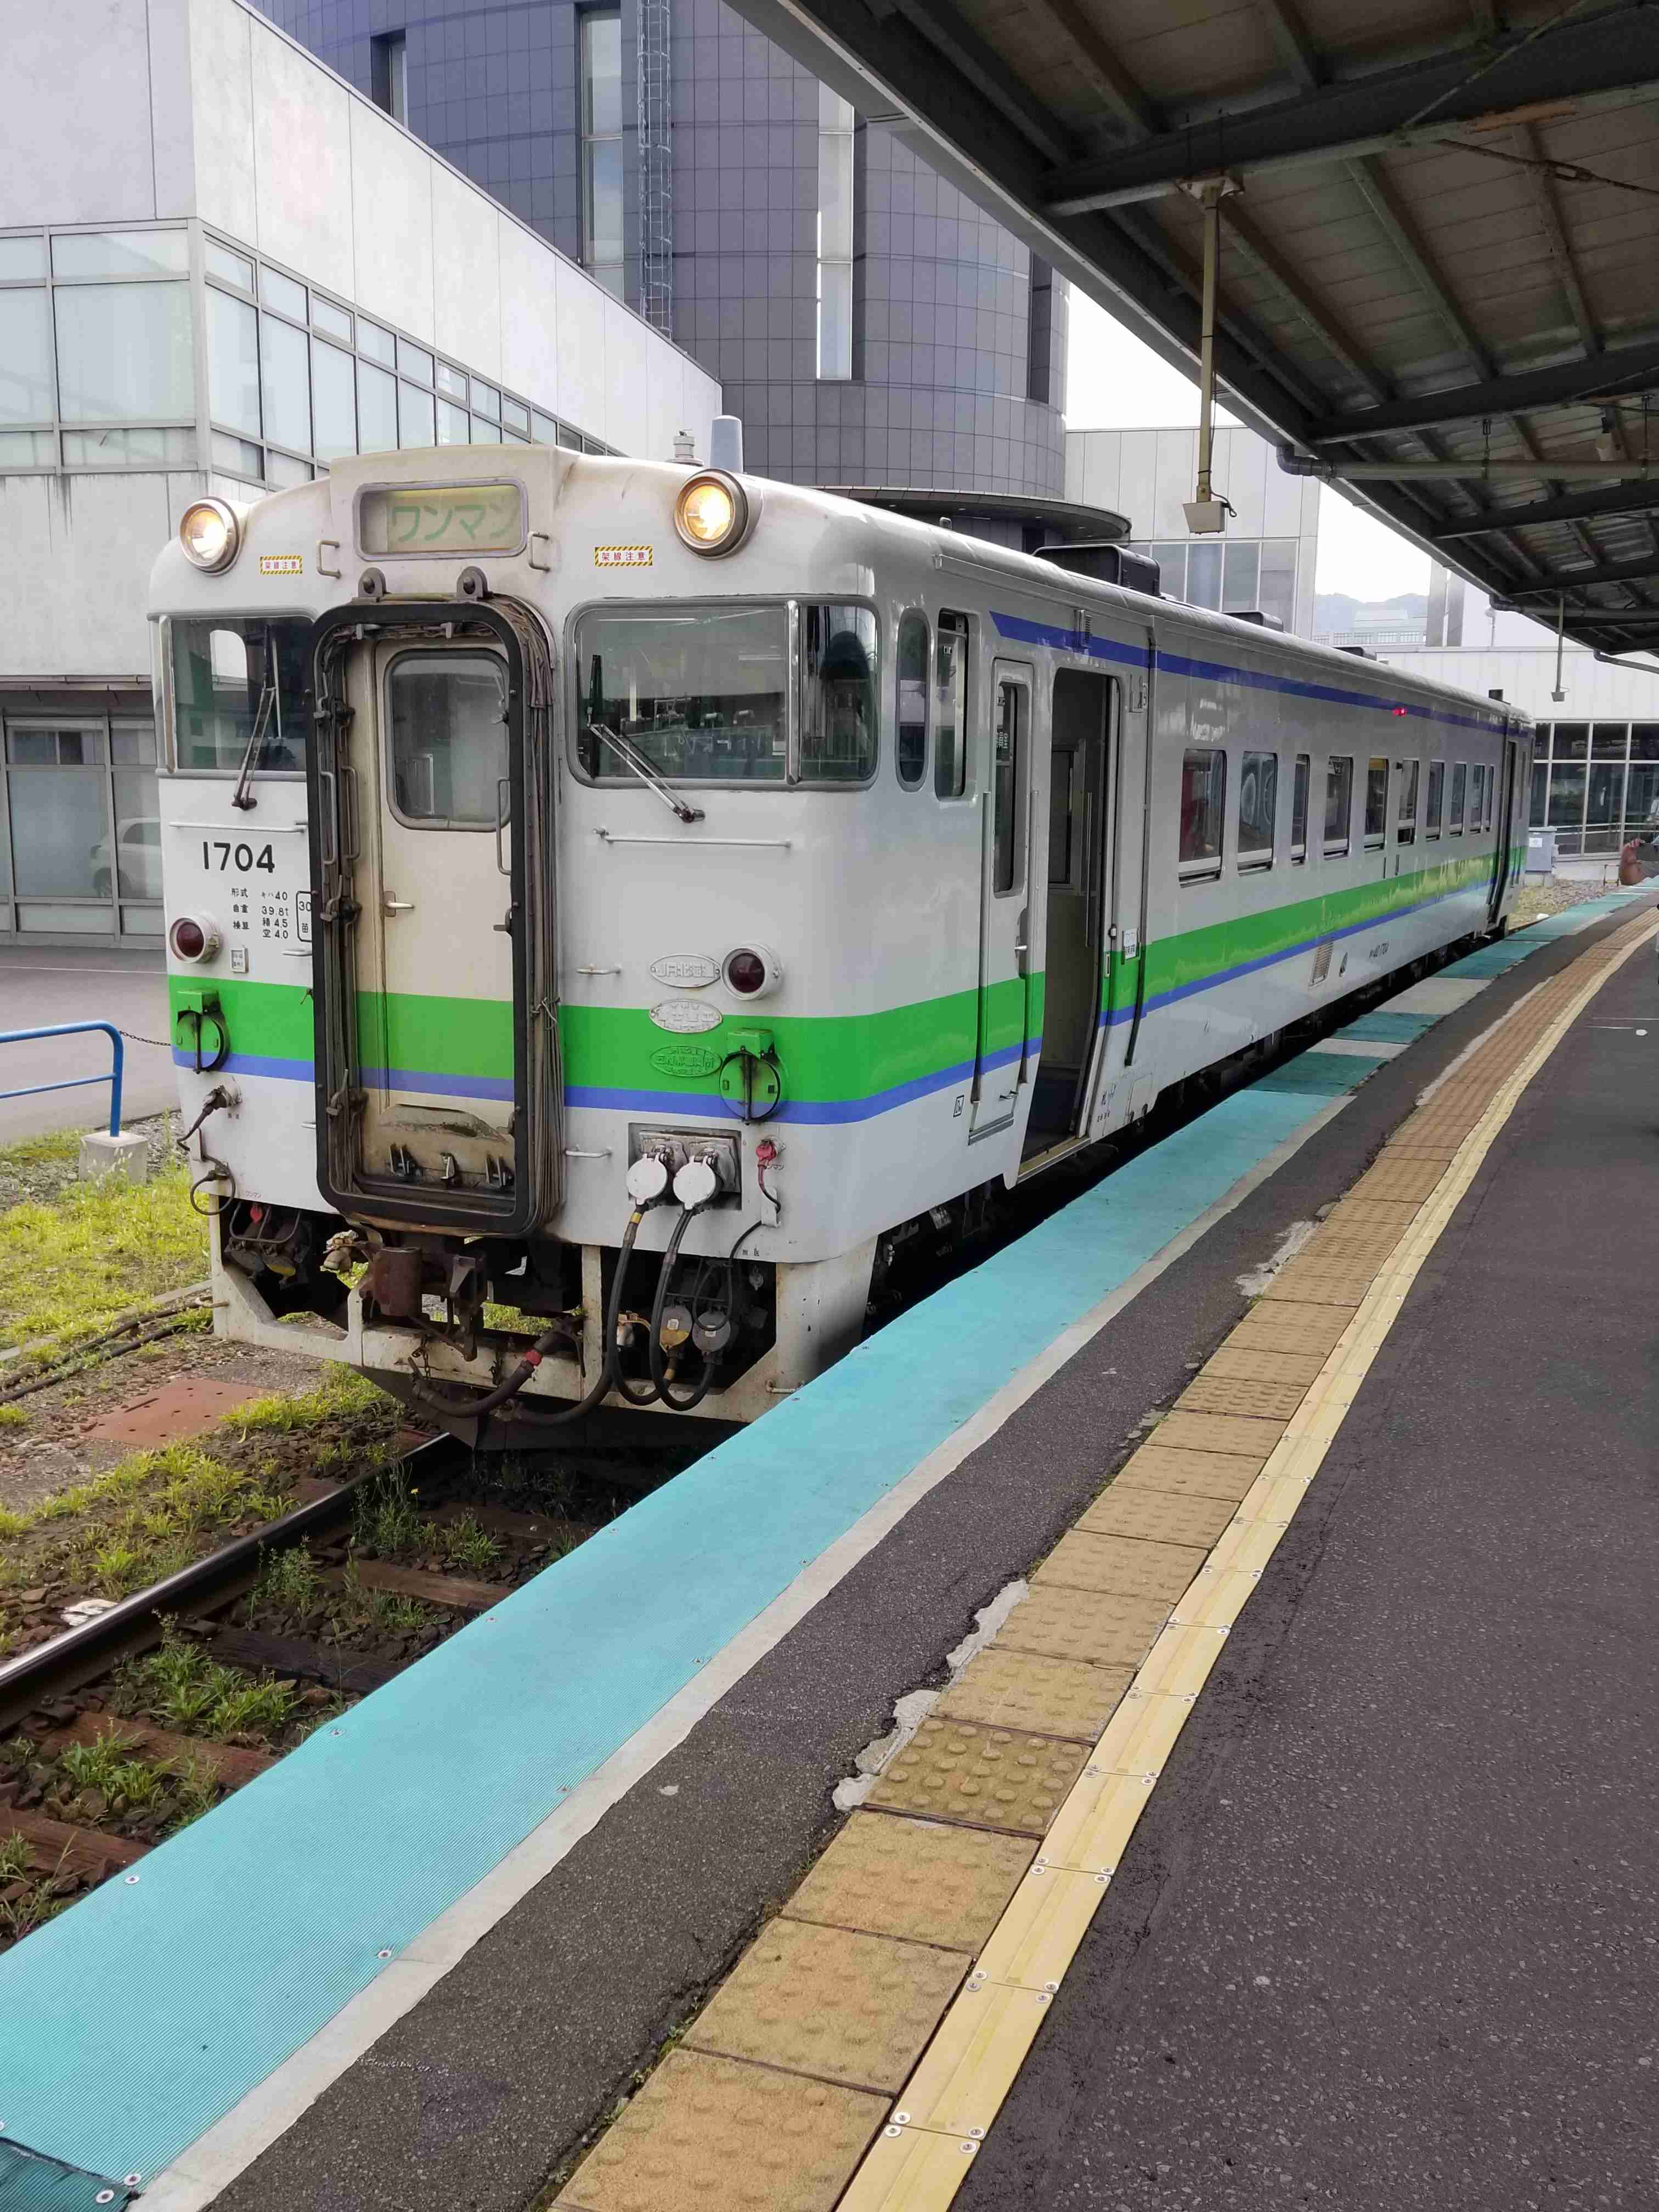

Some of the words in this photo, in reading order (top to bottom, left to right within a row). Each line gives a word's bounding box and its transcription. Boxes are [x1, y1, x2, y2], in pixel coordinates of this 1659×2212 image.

[392, 503, 519, 541] ワンマン
[602, 551, 645, 561] 架線注意
[203, 842, 275, 873] 1704
[231, 888, 248, 898] 形式
